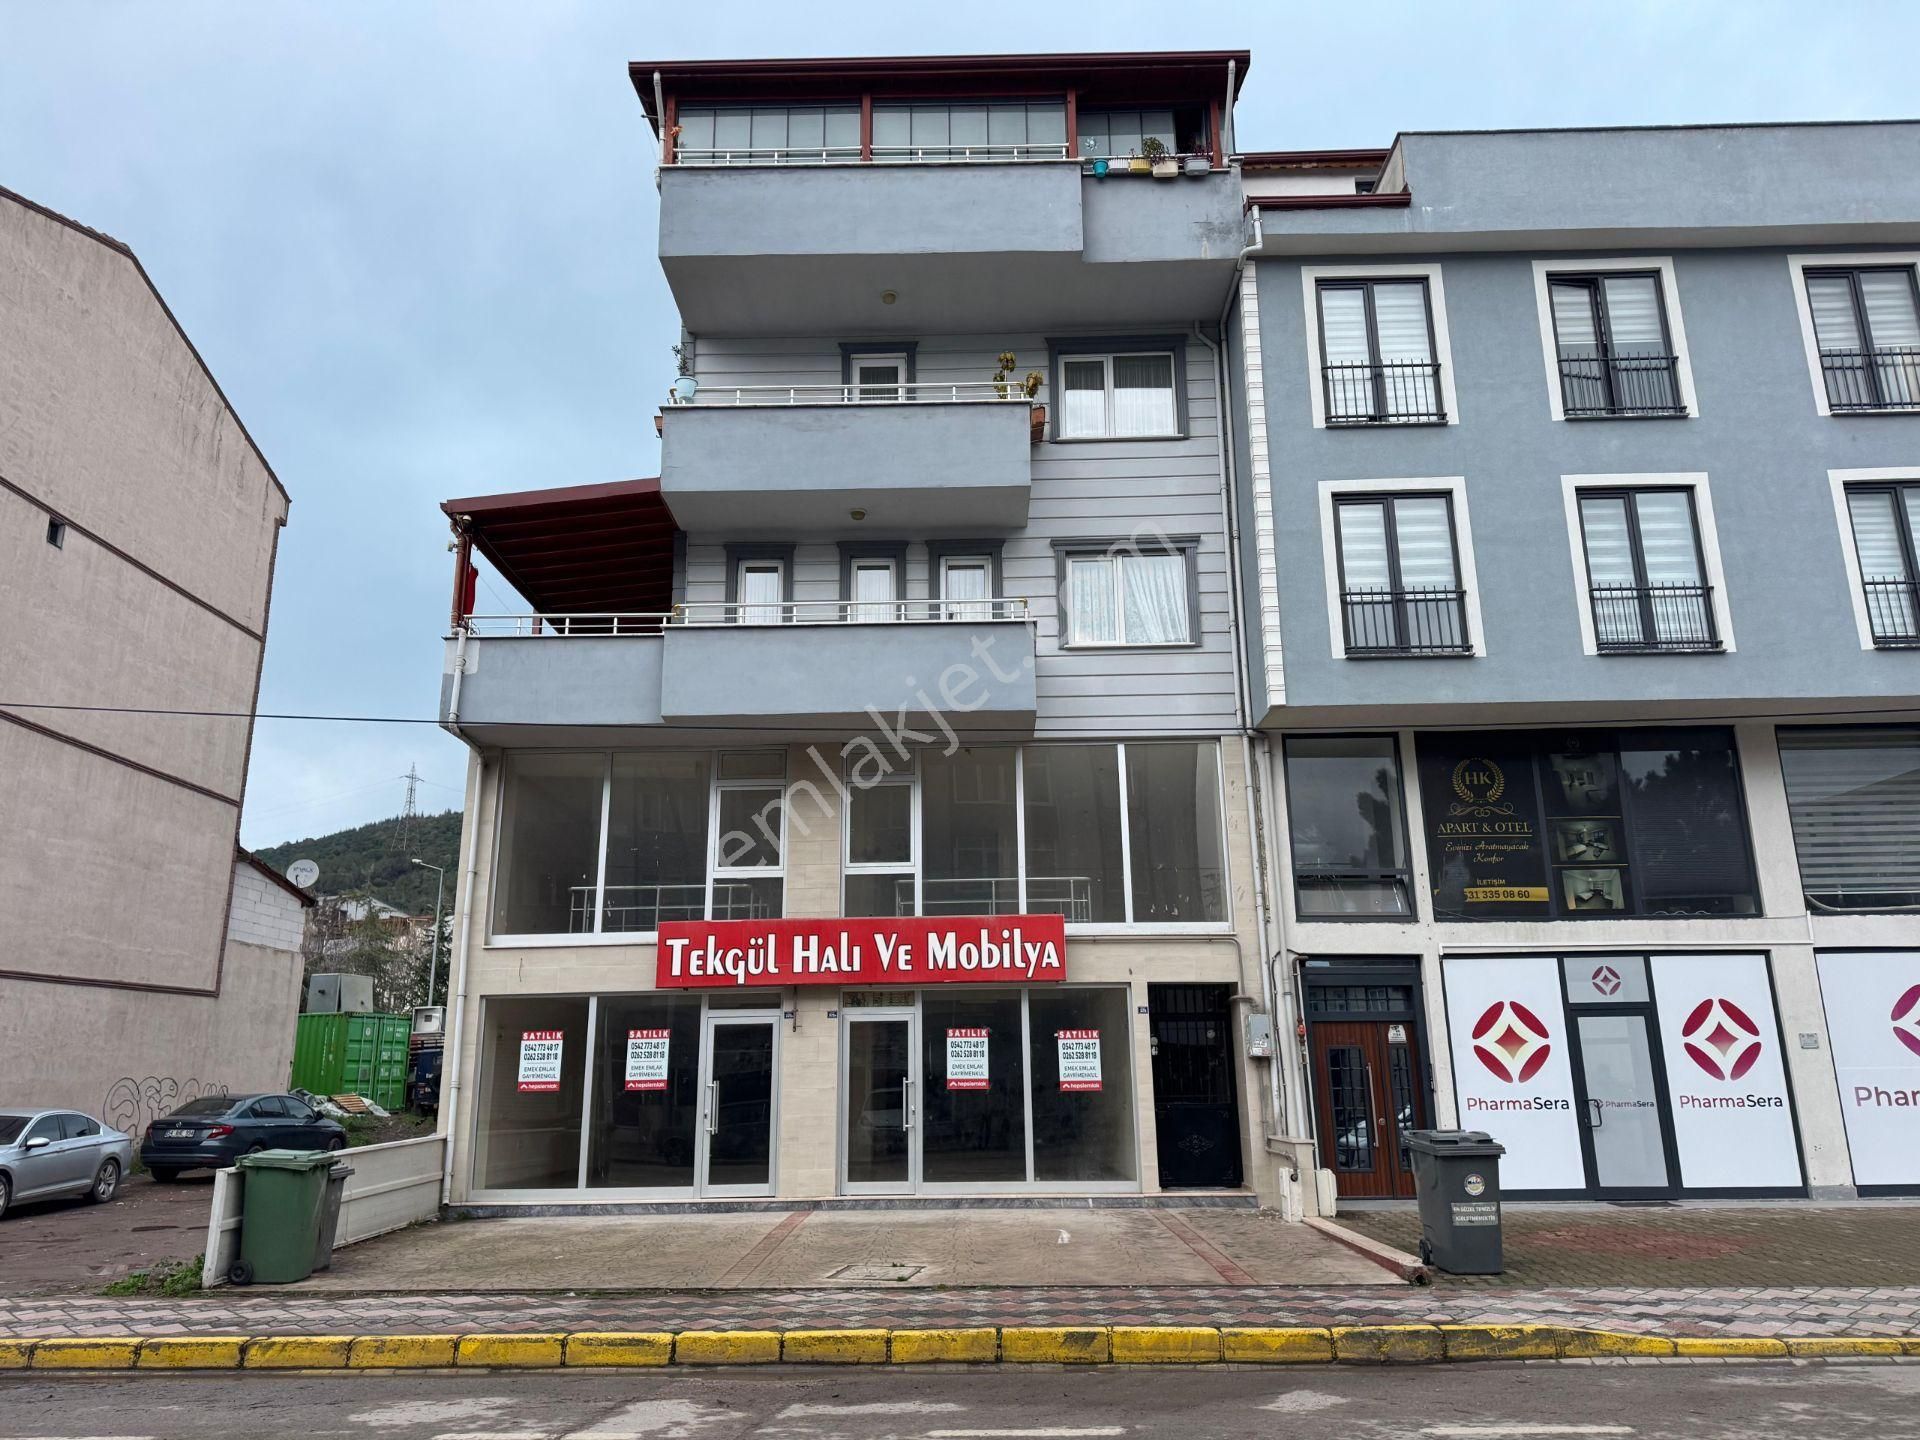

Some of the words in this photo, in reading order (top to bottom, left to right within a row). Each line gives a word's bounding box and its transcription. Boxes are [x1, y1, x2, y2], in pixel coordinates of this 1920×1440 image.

[1464, 771, 1492, 785] HK
[1437, 822, 1479, 834] APART
[1482, 822, 1493, 833] &
[1495, 821, 1533, 833] OTEL
[1482, 890, 1501, 899] 335
[1502, 890, 1515, 899] 08
[1517, 889, 1530, 899] 60
[665, 932, 780, 985] Tekgül
[791, 931, 862, 974] Halı
[872, 932, 913, 972] Ve
[926, 927, 1061, 978] Mobilya
[522, 1031, 563, 1040] SATILIK
[629, 1030, 669, 1038] SATILIK
[948, 1029, 987, 1037] SATILIK
[1059, 1030, 1099, 1038] SATILIK
[537, 1043, 546, 1051] 773
[643, 1042, 653, 1050] 773
[963, 1041, 972, 1049] 773
[1074, 1042, 1084, 1050] 773
[1466, 1096, 1570, 1111] PharmaSera
[1605, 1100, 1655, 1108] PharmaSera
[1679, 1094, 1784, 1109] PharmaSera
